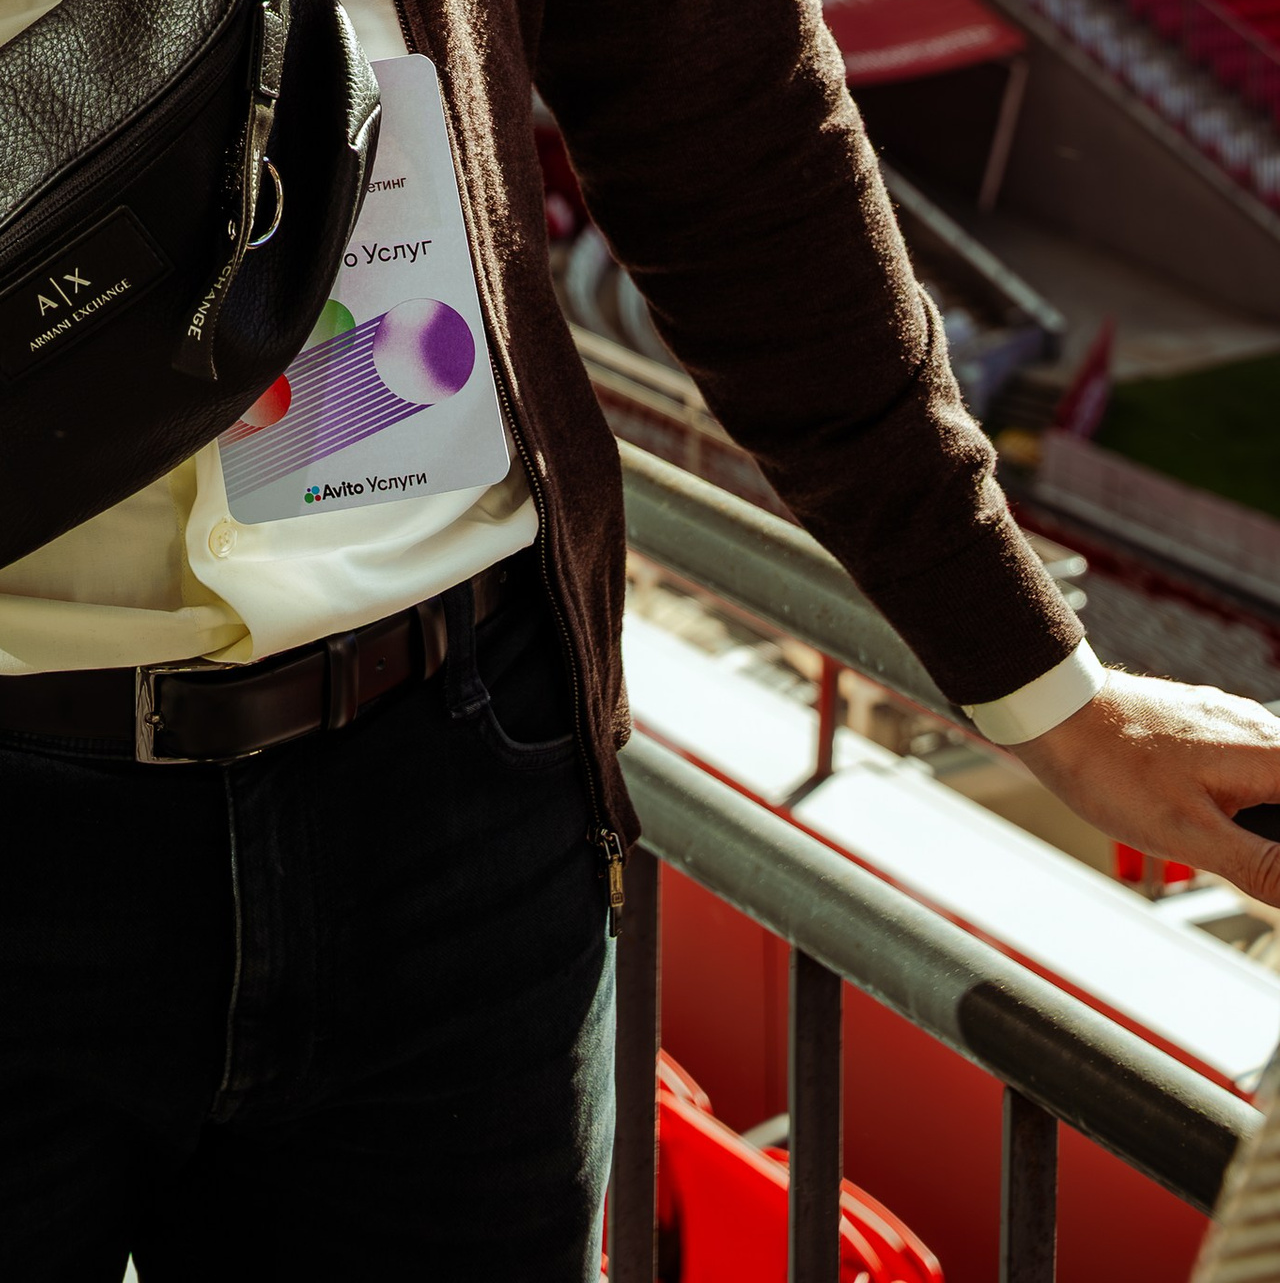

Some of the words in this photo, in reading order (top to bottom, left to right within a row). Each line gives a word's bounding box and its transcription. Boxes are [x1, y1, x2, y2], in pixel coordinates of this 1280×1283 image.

[367, 177, 407, 193] етинг
[362, 240, 432, 264] Услуг
[188, 255, 235, 341] CHANGE
[29, 319, 72, 352] ARMANI
[72, 278, 131, 322] EXCHANGE
[322, 481, 364, 500] Avito
[366, 472, 427, 492] Услуги
